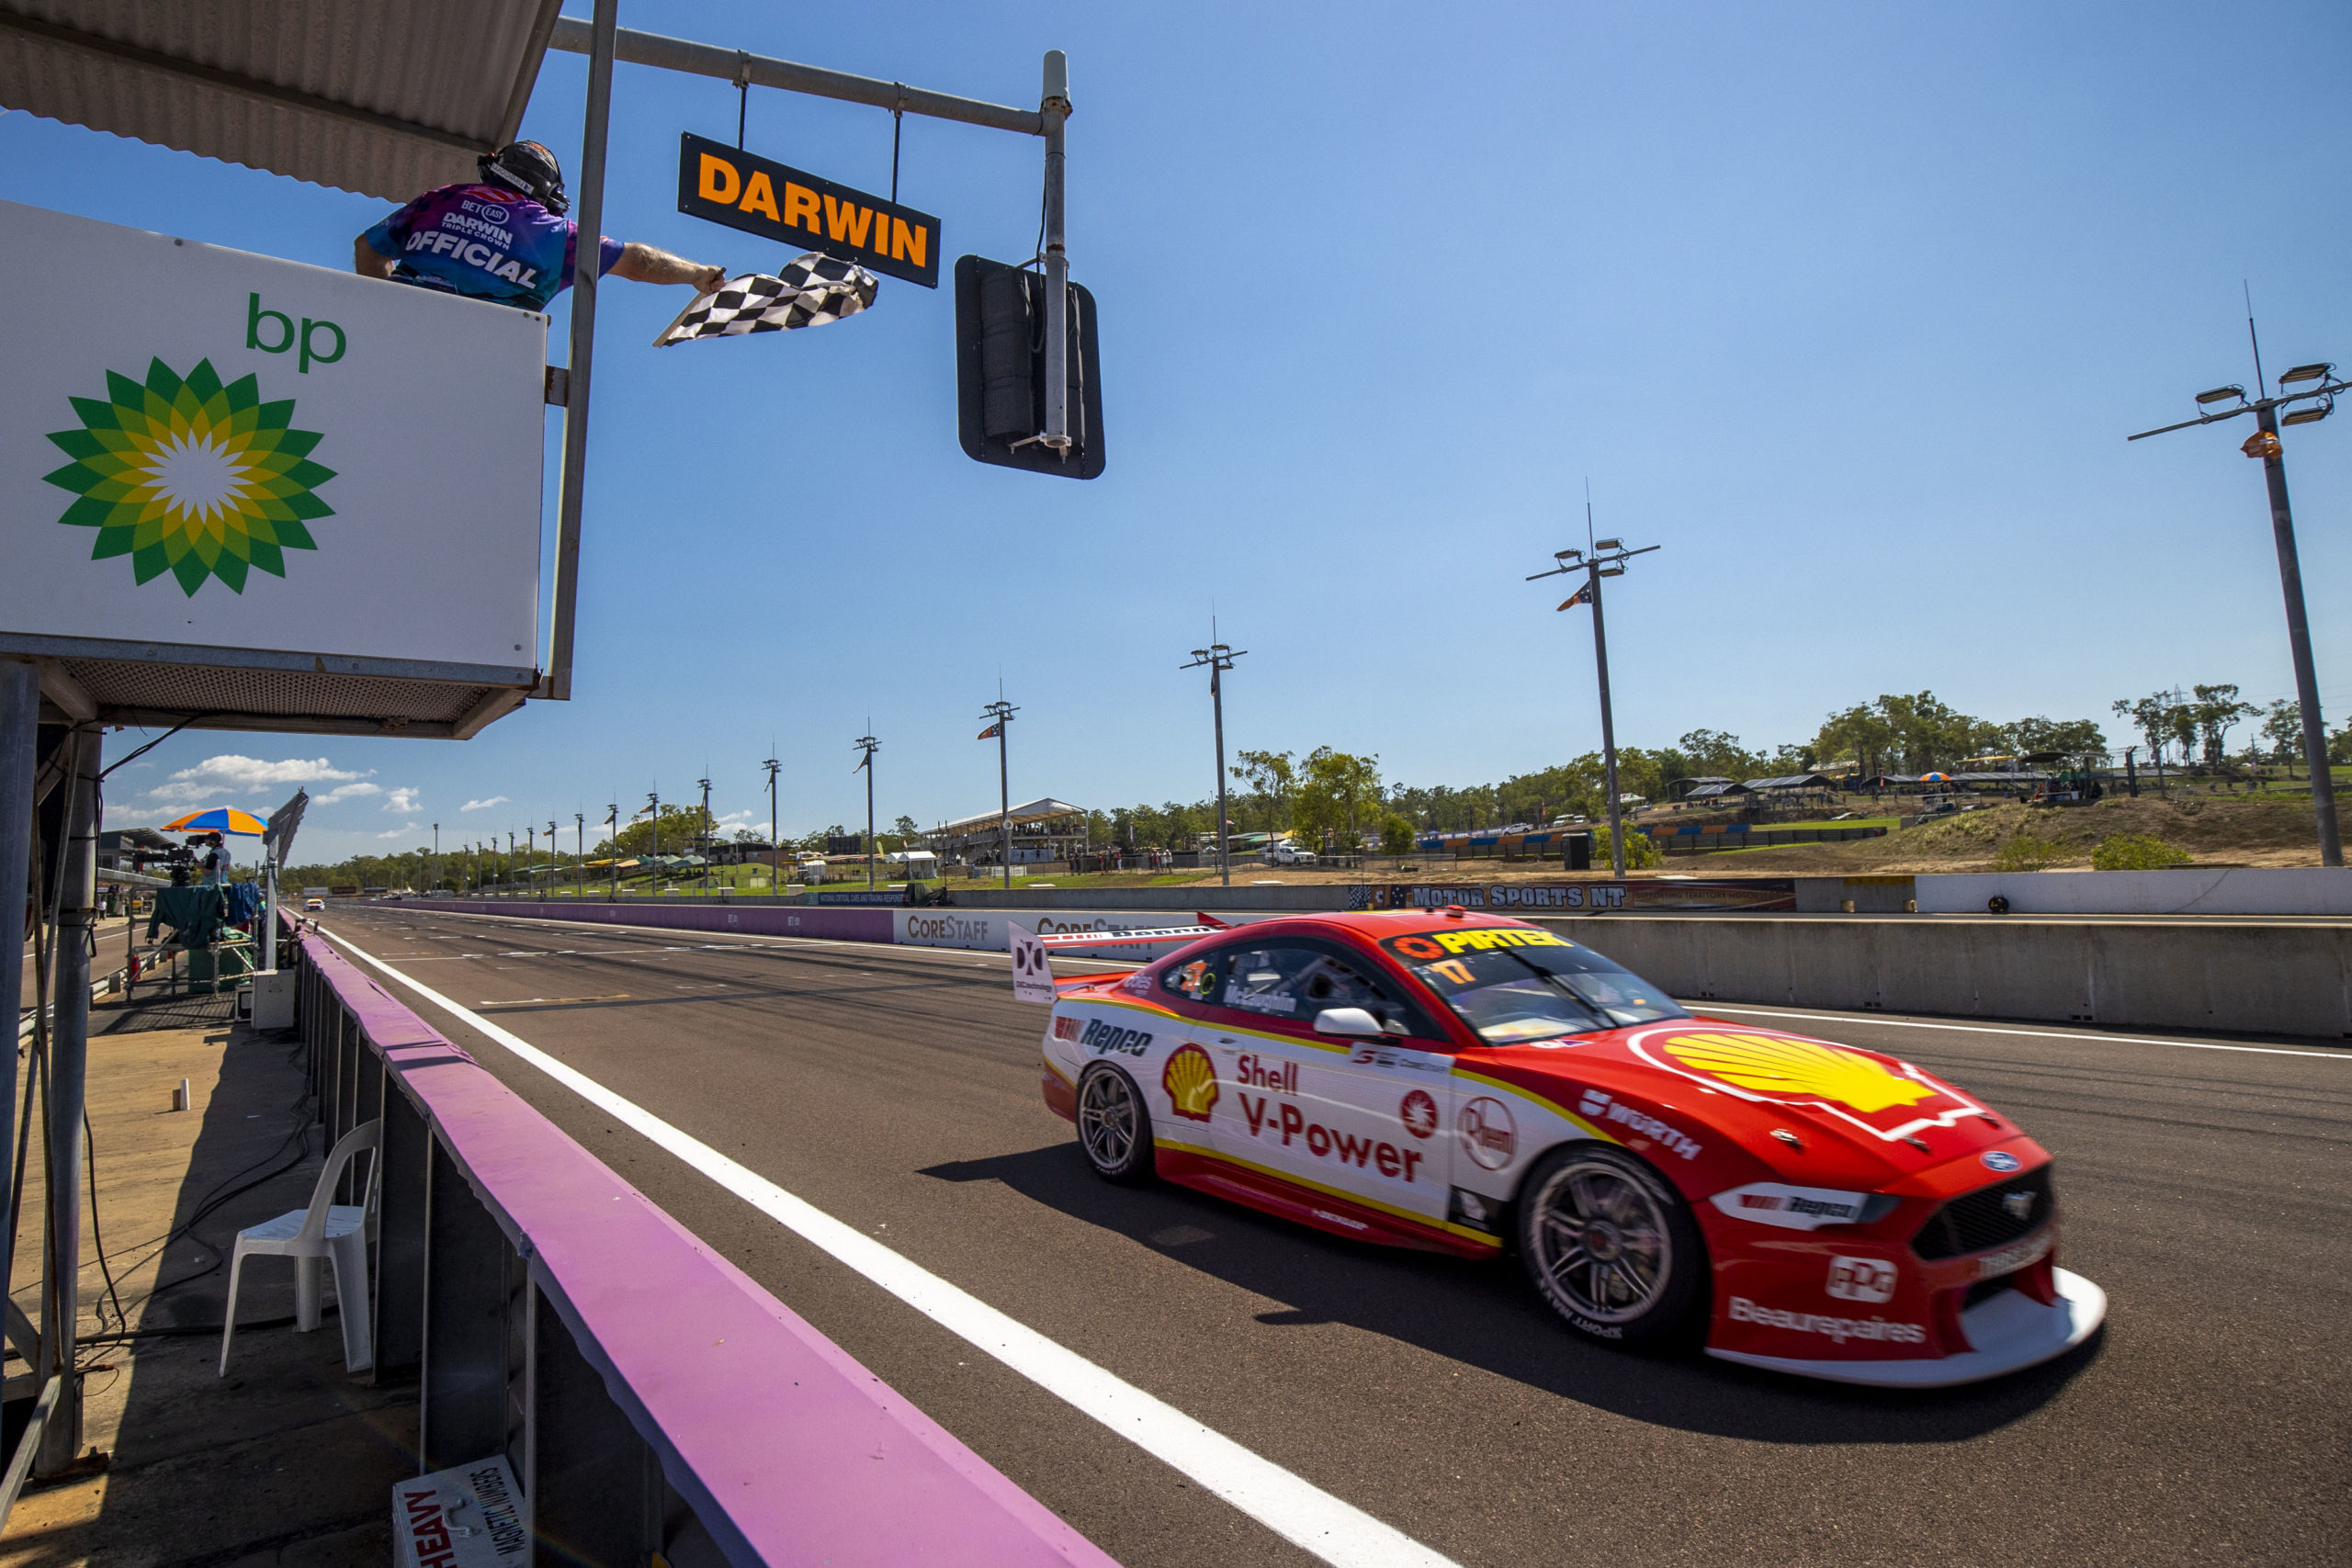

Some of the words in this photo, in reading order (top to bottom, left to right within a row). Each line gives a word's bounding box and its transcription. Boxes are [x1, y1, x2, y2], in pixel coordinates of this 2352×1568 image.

[443, 212, 513, 244] DARWIN
[461, 200, 483, 214] BET
[485, 209, 504, 220] EASY
[698, 152, 927, 268] DARWIN
[442, 222, 473, 235] TRIPLE
[474, 231, 510, 250] CROWN
[405, 231, 537, 289] OFFICIAL
[246, 292, 346, 375] bp
[1412, 886, 1484, 907] MOTOR
[1490, 886, 1583, 907] SPORTS
[1590, 886, 1625, 907] NT
[1431, 929, 1574, 953] PIRTEK
[1428, 959, 1476, 984] 17
[1080, 1018, 1153, 1057] Repco
[1237, 1055, 1298, 1096] Shell
[1238, 1092, 1423, 1183] V-Power
[1729, 1295, 1928, 1345] Beaurepaires
[469, 1467, 511, 1508] NUMBERS
[403, 1489, 458, 1568] HEAVY
[481, 1505, 526, 1557] MAGNETIC
